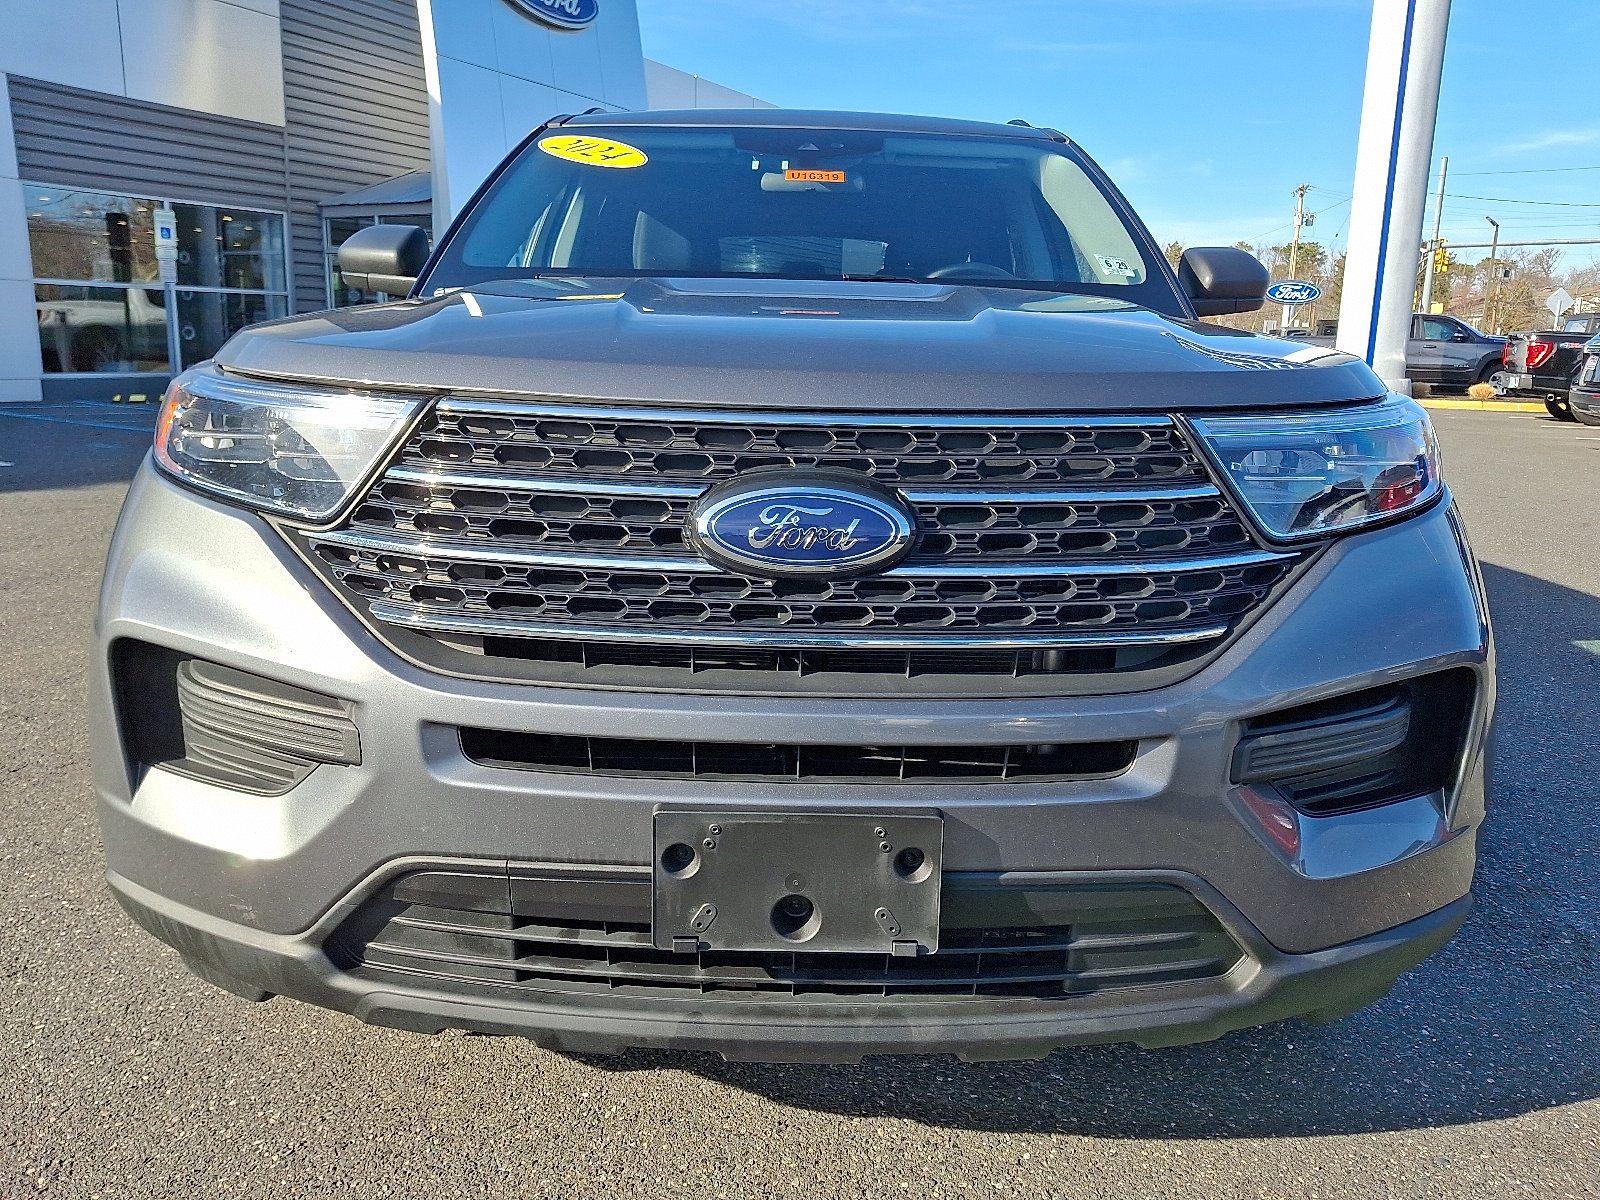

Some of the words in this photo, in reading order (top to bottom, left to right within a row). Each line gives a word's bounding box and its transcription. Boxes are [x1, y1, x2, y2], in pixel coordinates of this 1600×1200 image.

[791, 172, 840, 181] U16319
[1104, 259, 1113, 268] 6
[1275, 285, 1311, 300] Ford
[748, 504, 861, 550] Ford
